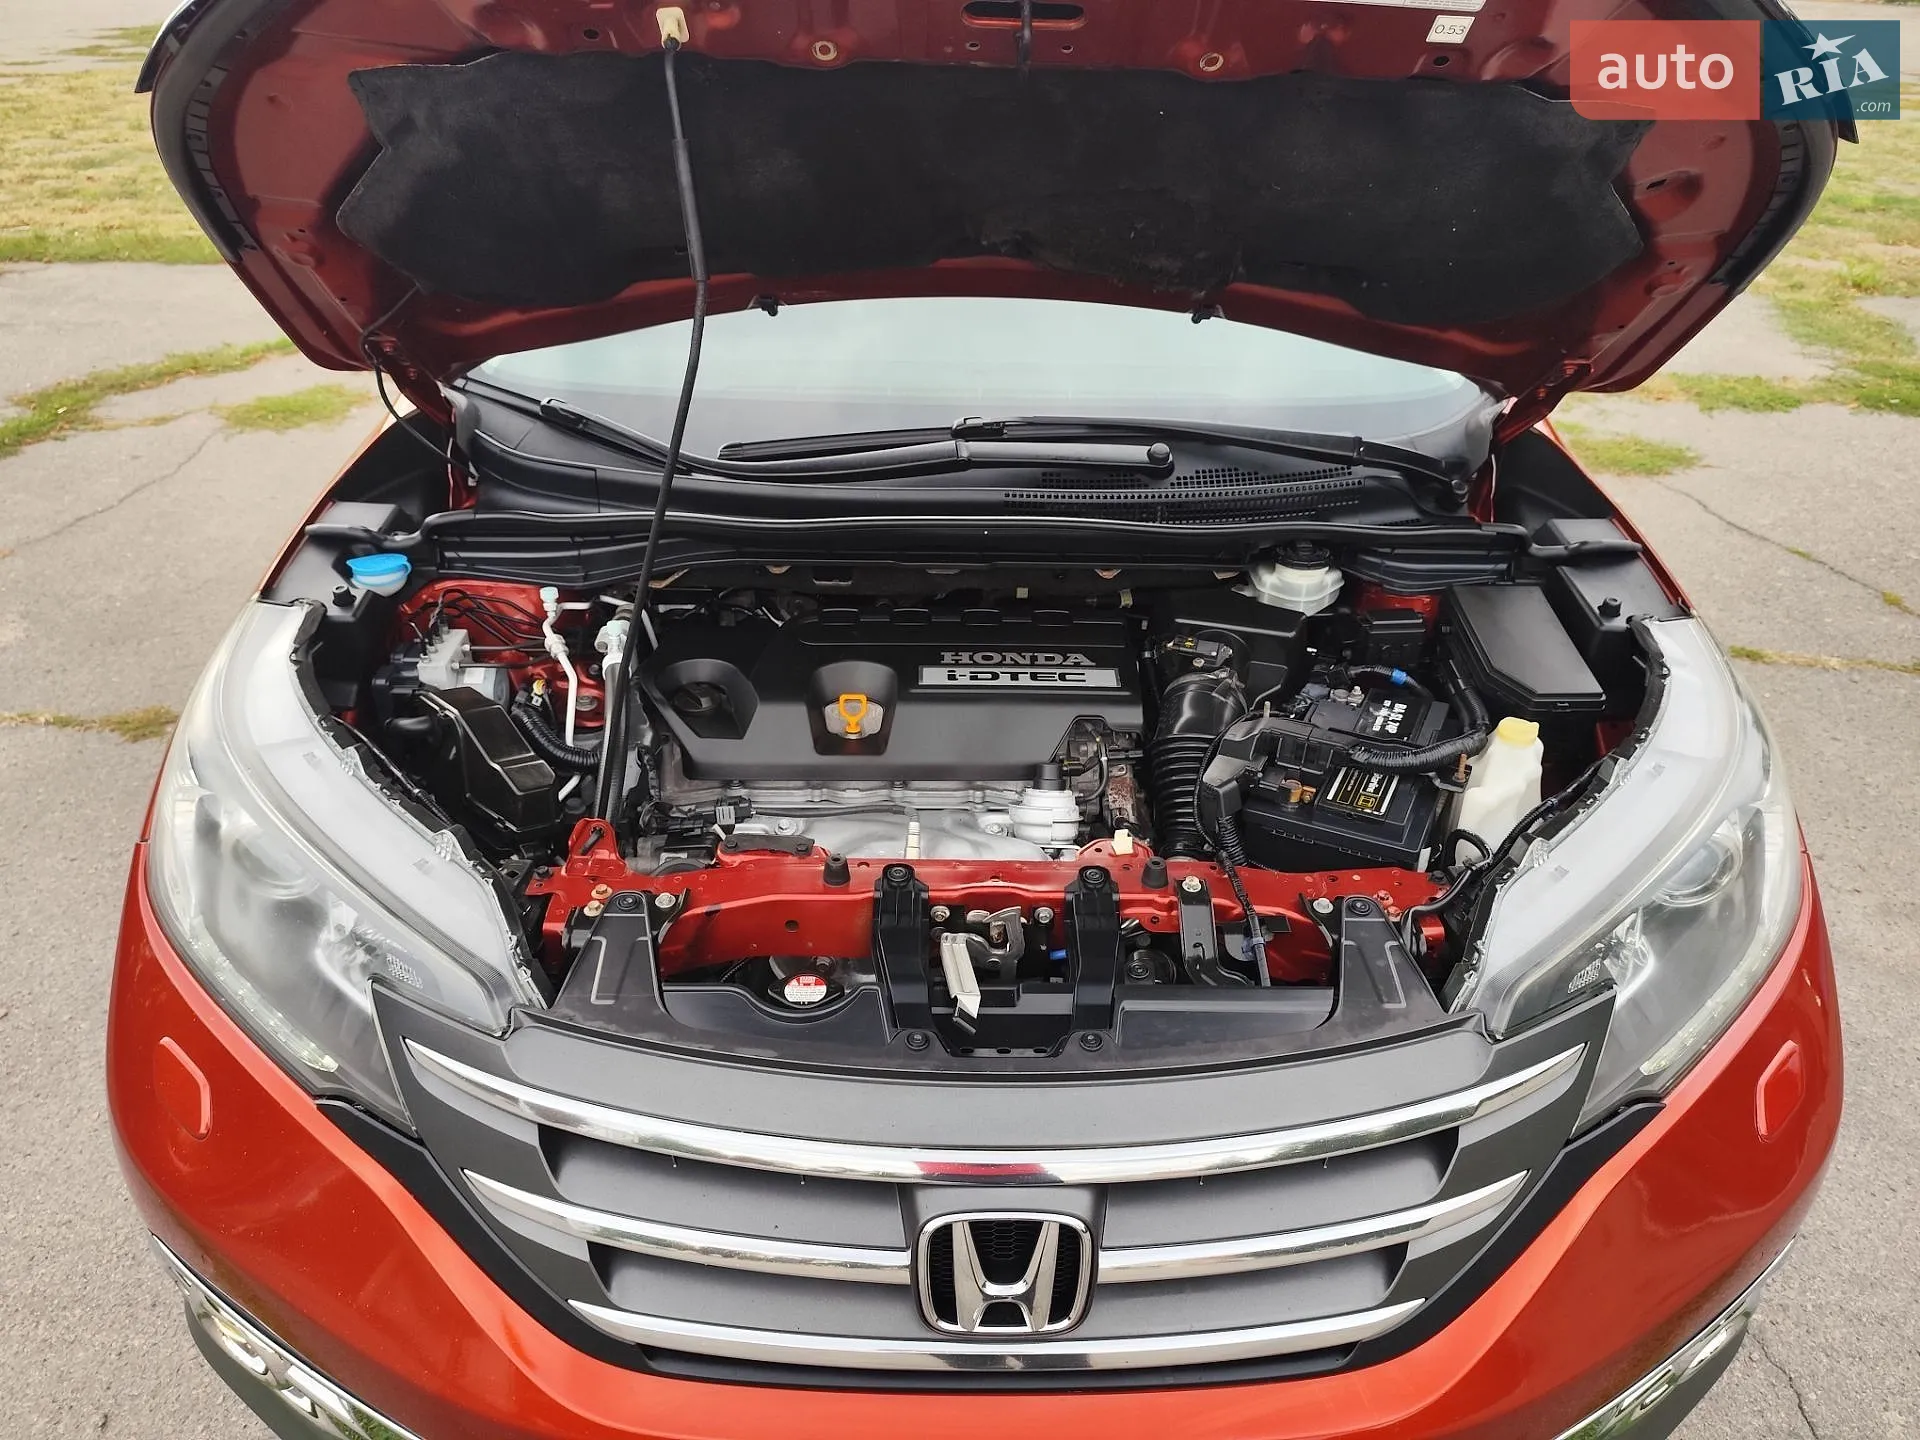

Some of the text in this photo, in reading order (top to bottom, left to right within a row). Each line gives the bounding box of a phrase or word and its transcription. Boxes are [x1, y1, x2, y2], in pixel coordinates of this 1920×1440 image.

[1434, 24, 1466, 35] 0.53
[940, 651, 1096, 666] HONDA
[946, 669, 1087, 683] i-DTEC
